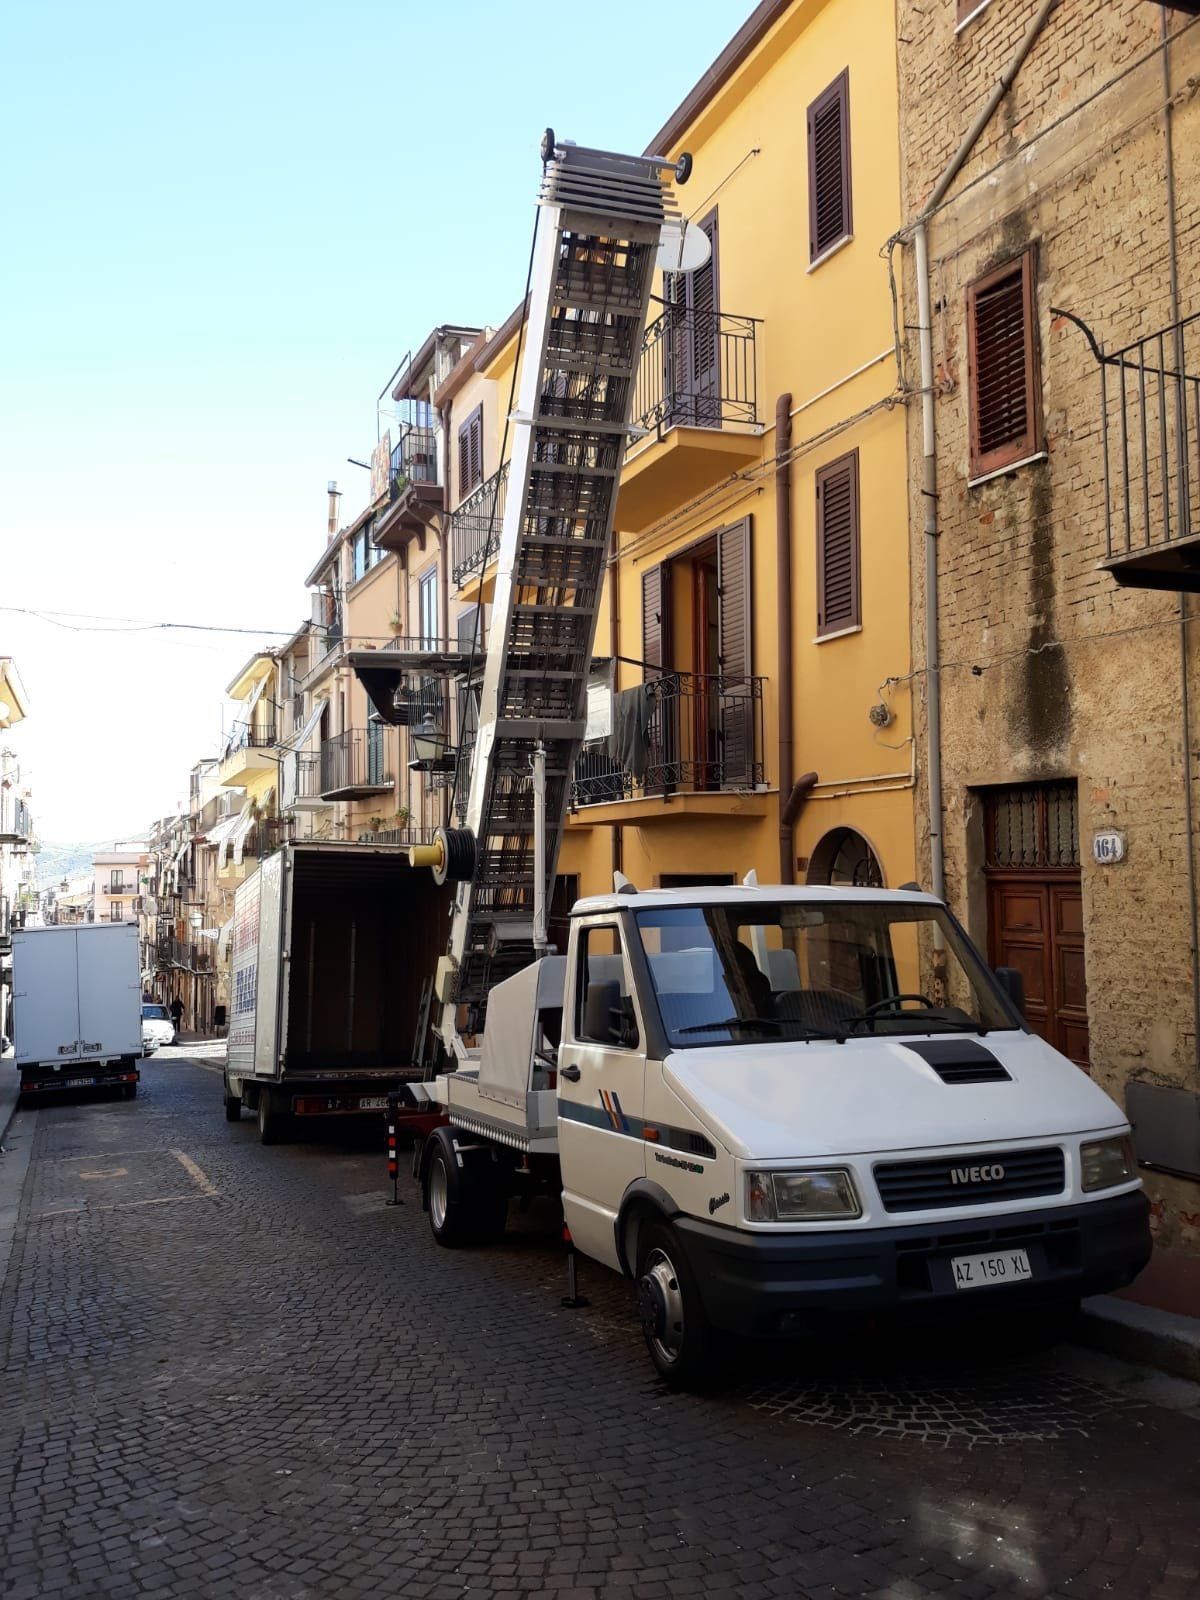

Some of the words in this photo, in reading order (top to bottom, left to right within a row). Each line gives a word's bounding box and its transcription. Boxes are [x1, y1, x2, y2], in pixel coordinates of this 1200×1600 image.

[1095, 838, 1118, 859] 164
[951, 1164, 1005, 1184] IVECO
[956, 1262, 974, 1282] AZ
[980, 1258, 1006, 1279] 150
[1011, 1255, 1030, 1275] XL
